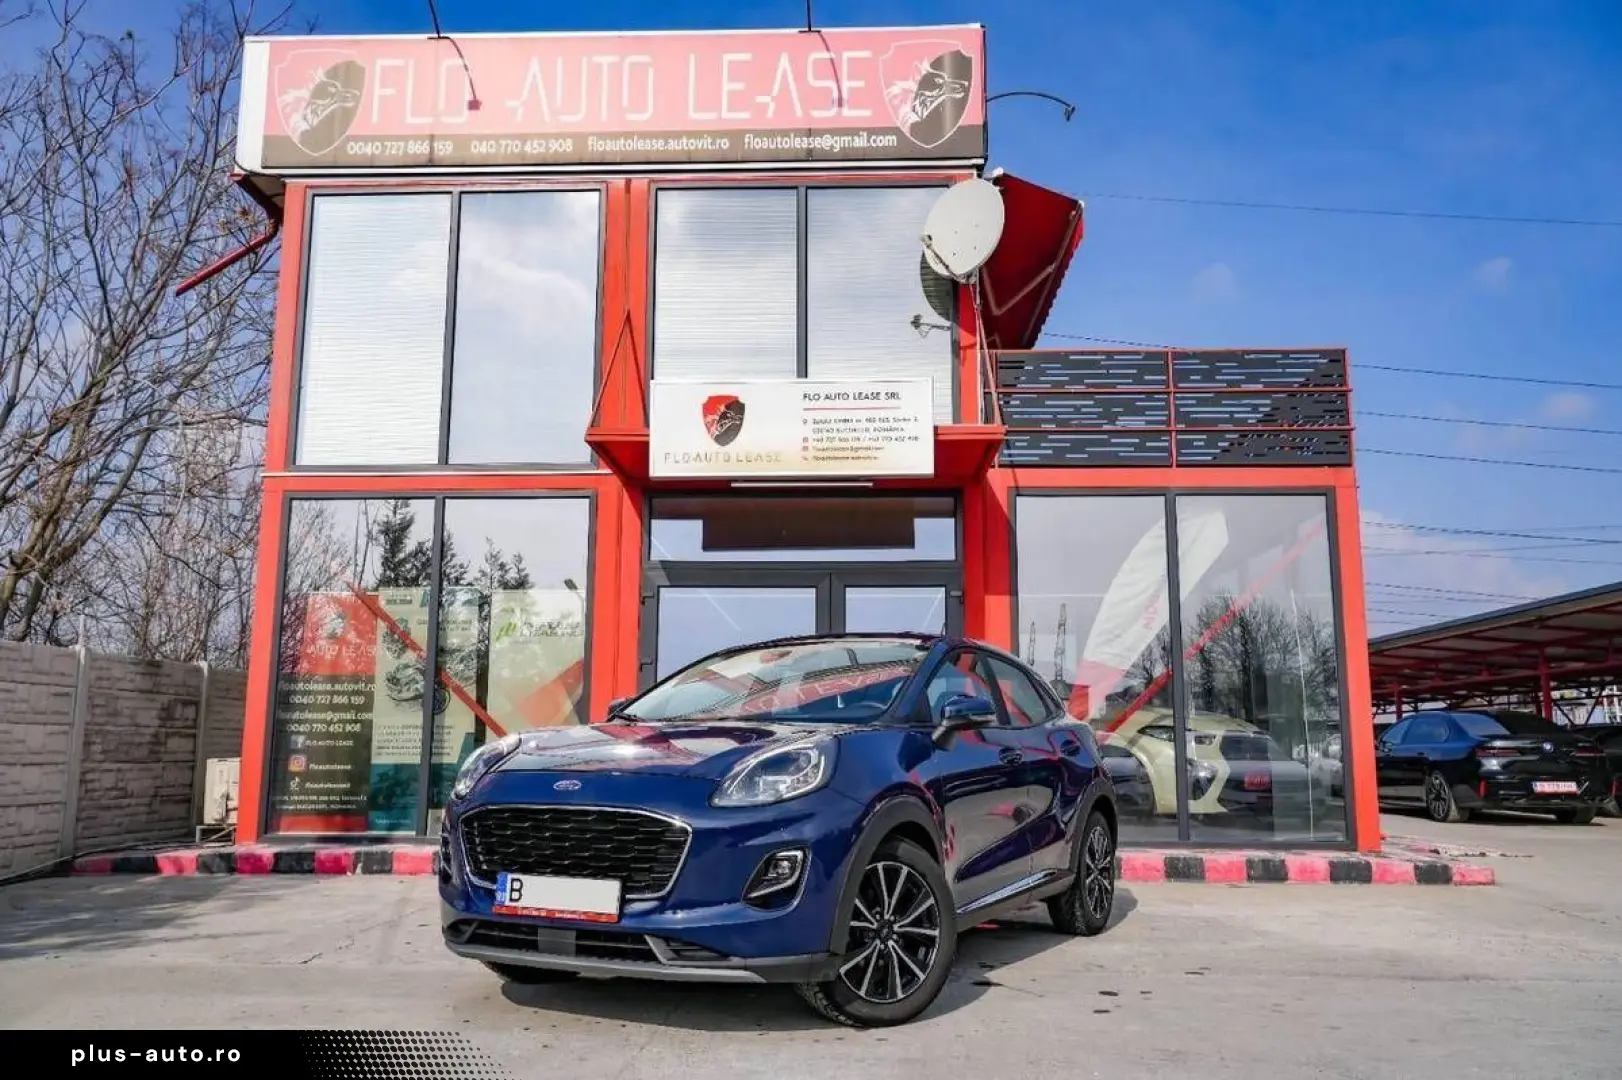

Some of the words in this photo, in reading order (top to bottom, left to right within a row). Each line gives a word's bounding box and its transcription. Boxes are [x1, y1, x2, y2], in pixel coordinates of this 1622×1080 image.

[371, 56, 471, 125] FLO
[505, 53, 655, 124] AUTO
[688, 49, 872, 121] LEASE
[347, 140, 382, 156] 0040
[384, 140, 405, 156] 727
[406, 139, 430, 155] 866
[433, 140, 453, 155] 159
[470, 140, 497, 154] 040
[499, 139, 521, 155] 770
[523, 139, 547, 154] 452
[548, 137, 573, 153] 908
[588, 134, 730, 153] floautolease.autovit.ro
[744, 132, 897, 153] floautolease@gmail.com
[802, 392, 821, 401] FLO
[823, 392, 850, 401] AUTO
[852, 391, 881, 401] LEASE
[884, 391, 902, 401] SRL
[664, 452, 690, 465] FLO
[315, 695, 331, 705] 727
[311, 723, 327, 732] 770
[509, 878, 524, 902] B
